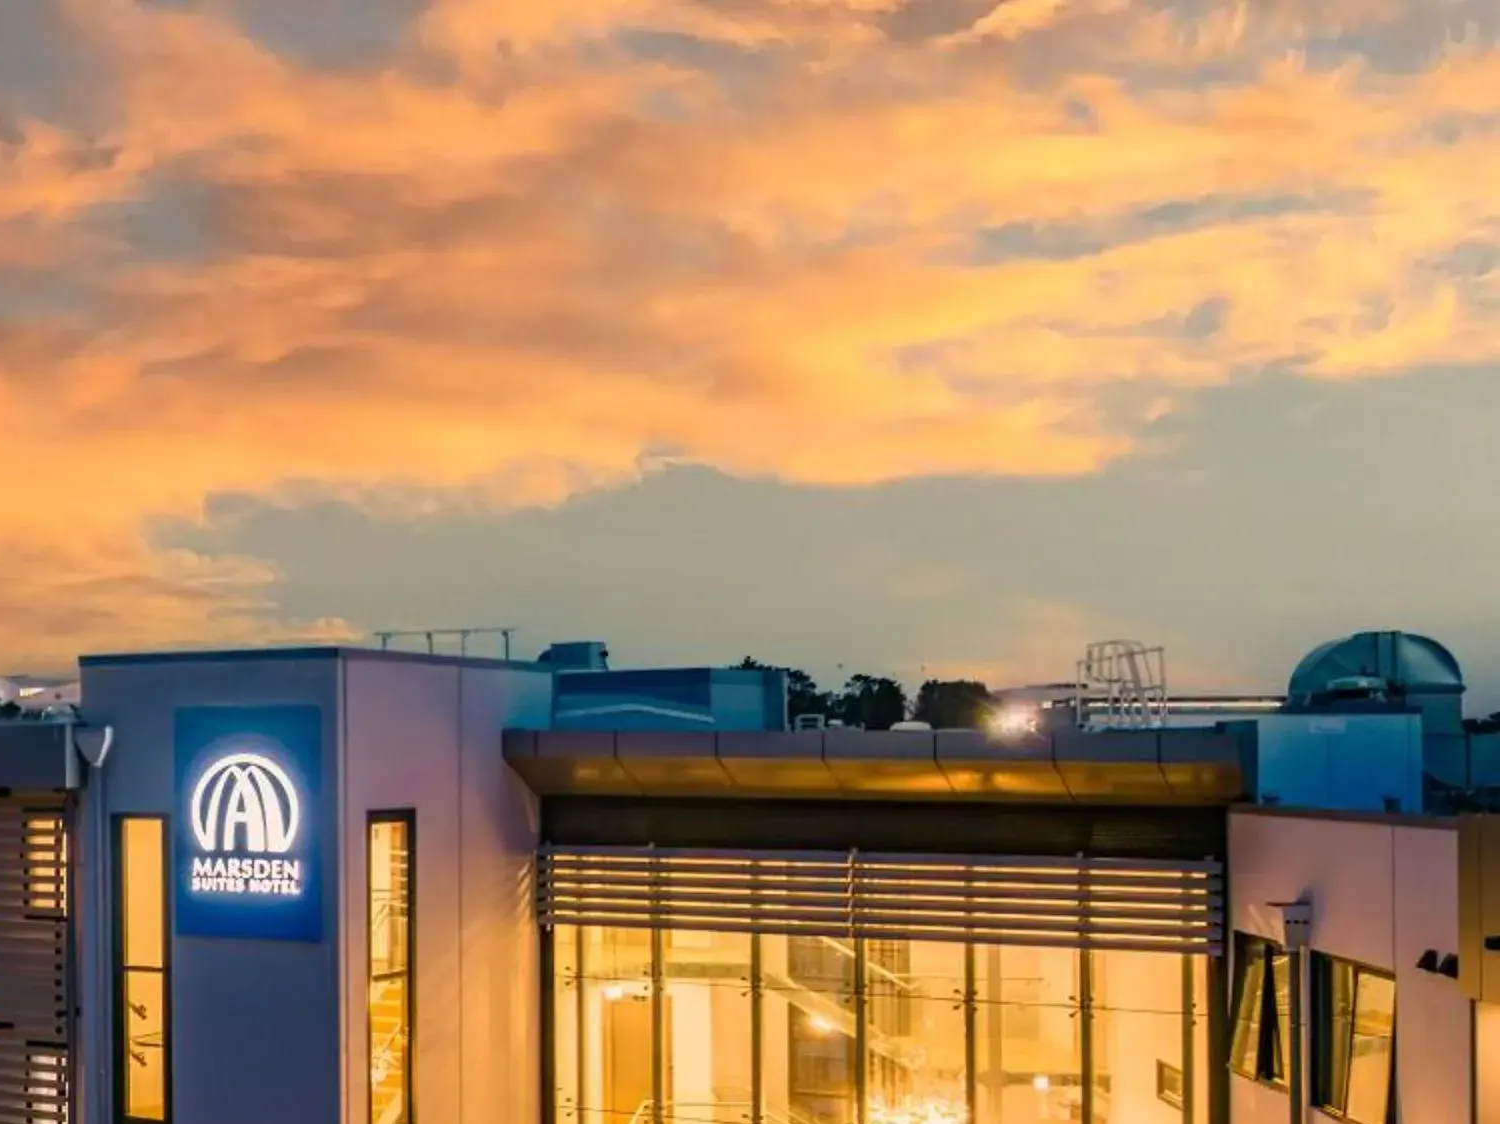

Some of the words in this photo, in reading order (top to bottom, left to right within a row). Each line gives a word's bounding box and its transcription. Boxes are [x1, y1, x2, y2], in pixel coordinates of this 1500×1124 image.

[192, 857, 299, 880] MARSDEN
[191, 877, 245, 893] SUITES
[249, 879, 301, 895] HOTEL
